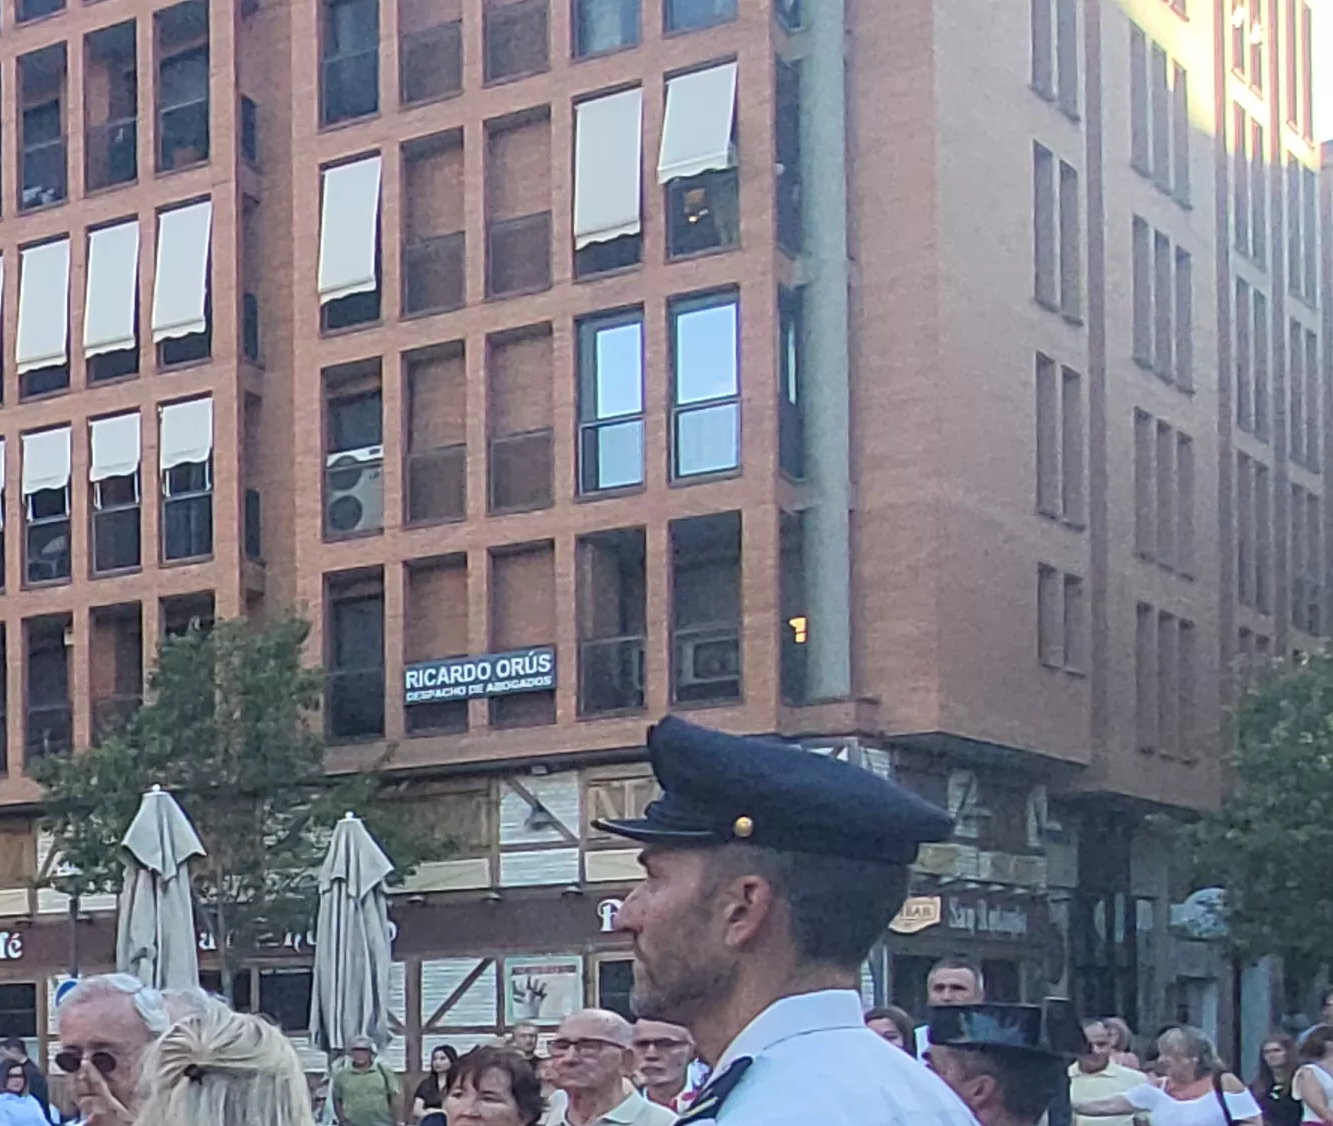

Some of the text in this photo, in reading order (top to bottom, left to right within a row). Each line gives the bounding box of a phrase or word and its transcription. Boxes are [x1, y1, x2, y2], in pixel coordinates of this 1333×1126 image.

[405, 651, 551, 689] RICARDO ORÚS
[486, 675, 552, 692] ABOGADOS
